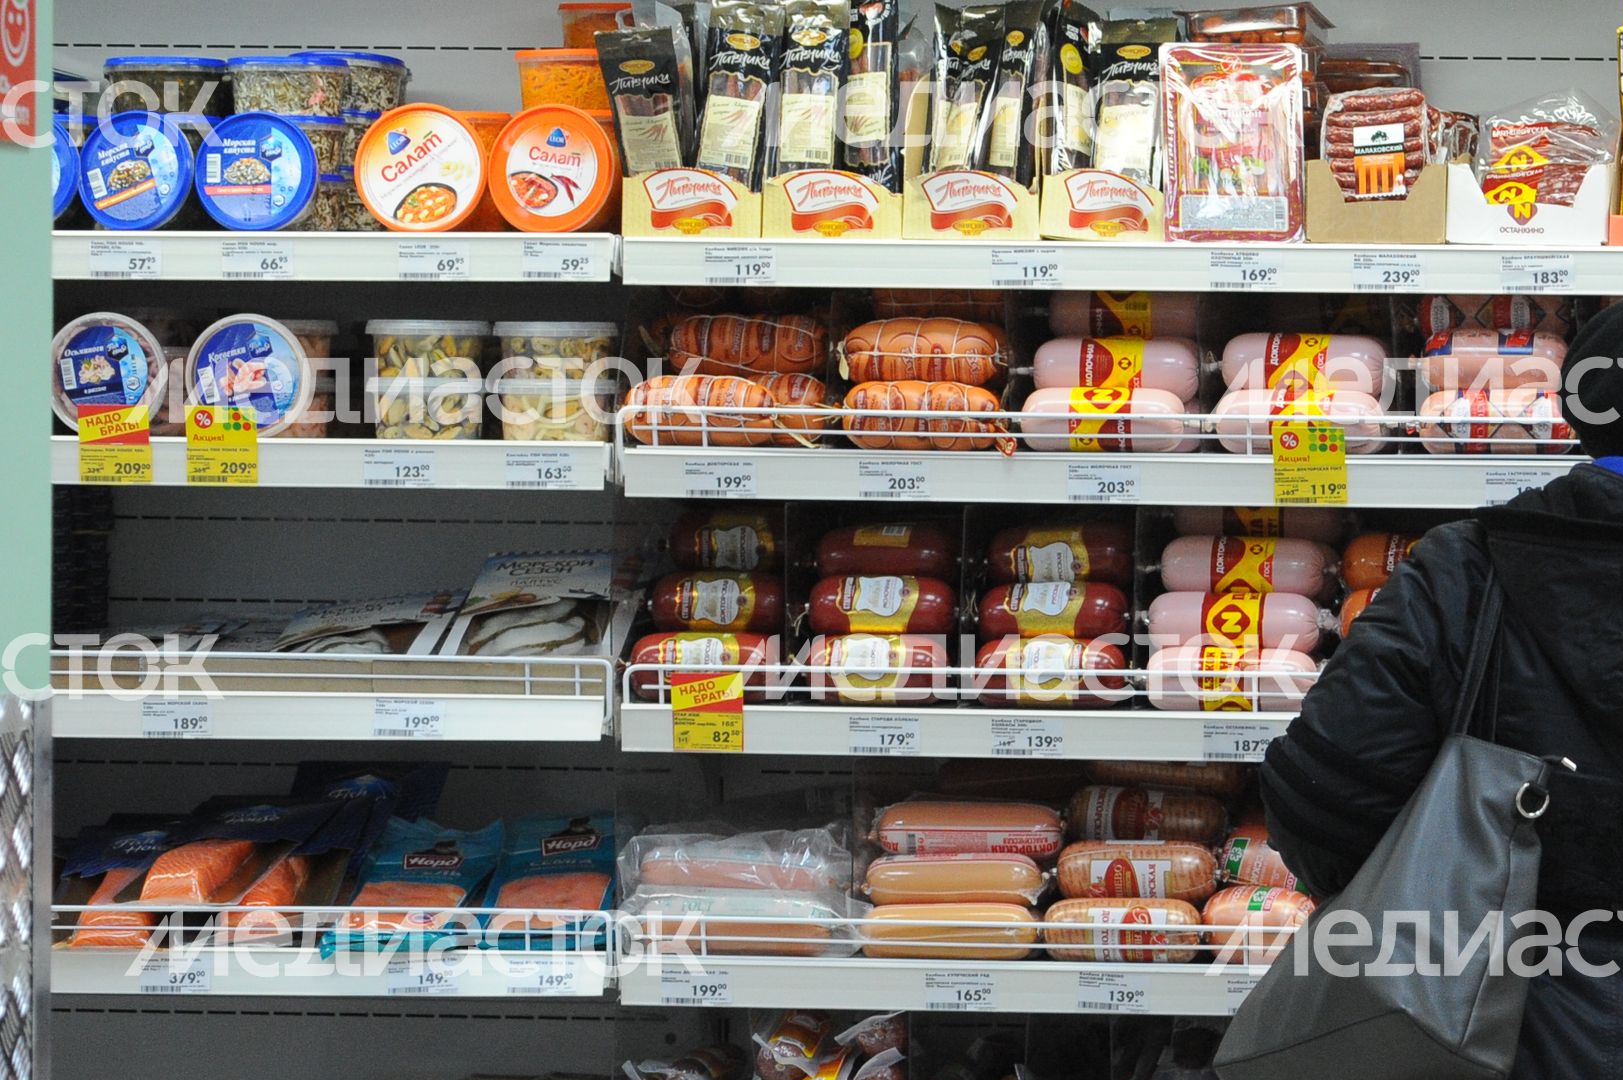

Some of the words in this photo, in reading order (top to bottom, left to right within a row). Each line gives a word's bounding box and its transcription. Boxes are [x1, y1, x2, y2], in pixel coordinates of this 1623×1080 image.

[223, 139, 256, 147] Морская
[223, 146, 256, 154] капуста
[380, 131, 443, 183] Салат
[528, 146, 581, 167] Салат
[85, 412, 121, 428] НАДО
[100, 422, 139, 436] БРАТЬ!
[193, 433, 225, 442] Акция!
[1278, 455, 1311, 463] Акция!
[679, 681, 715, 697] НАДО
[548, 836, 597, 851] Норд
